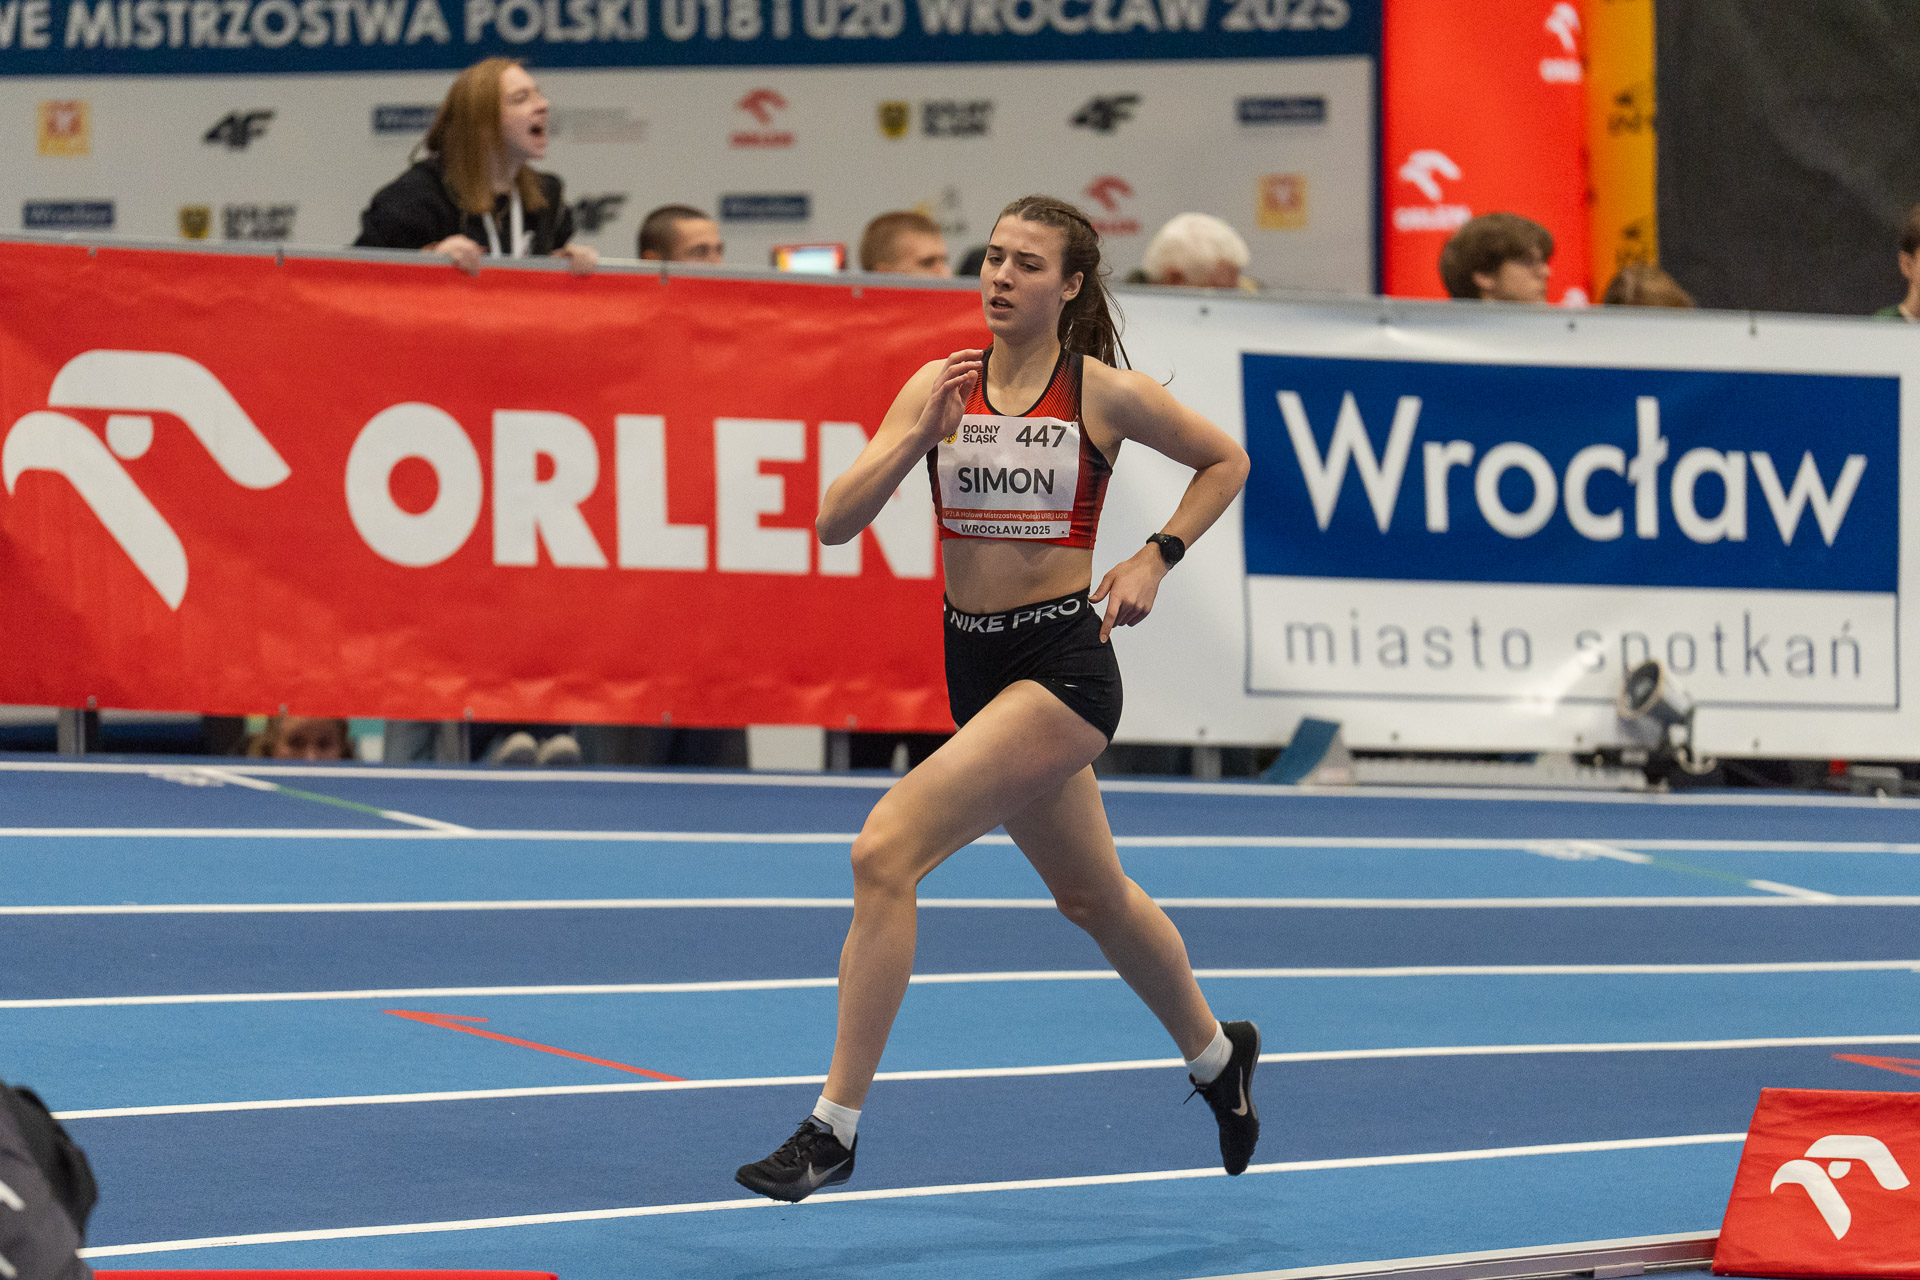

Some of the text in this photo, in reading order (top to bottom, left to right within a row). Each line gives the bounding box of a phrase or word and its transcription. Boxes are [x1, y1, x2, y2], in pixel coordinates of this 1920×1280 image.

[63, 0, 451, 48] MISTRZOSTWA
[464, 0, 647, 44] POLSKI
[661, 0, 763, 42] U18
[804, 0, 906, 40] U20
[918, 0, 1206, 36] WROCŁAW
[1219, 0, 1351, 32] 2025
[962, 433, 997, 445] ŚLĄSK
[963, 425, 1000, 434] DOLNY
[1015, 425, 1067, 448] 447
[957, 467, 1055, 495] SIMON
[1276, 390, 1868, 547] Wrocław
[345, 401, 936, 580] ORLEN
[961, 524, 1051, 535] WROCŁAW 2025
[950, 598, 1081, 633] NIKE PRO
[1285, 608, 1862, 679] miasto spotkań
